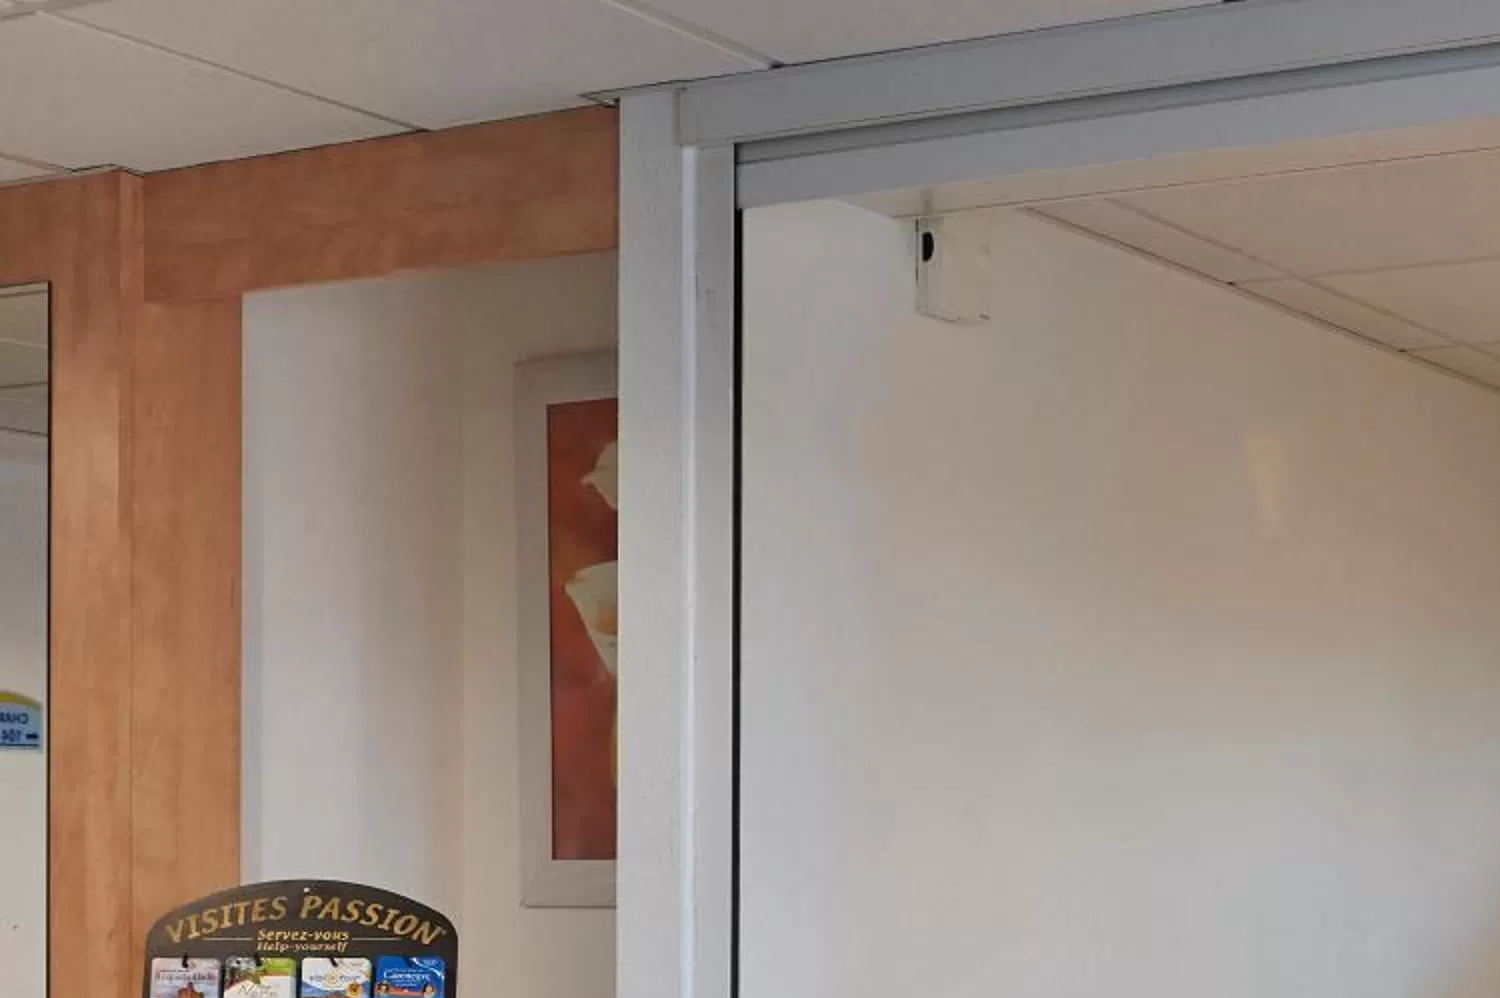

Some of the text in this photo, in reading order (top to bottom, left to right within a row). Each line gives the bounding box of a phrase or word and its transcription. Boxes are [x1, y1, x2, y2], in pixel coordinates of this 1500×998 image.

[164, 894, 442, 946] VISITES PASSION
[257, 928, 350, 942] Servez-vous
[256, 941, 350, 953] Help-yourself
